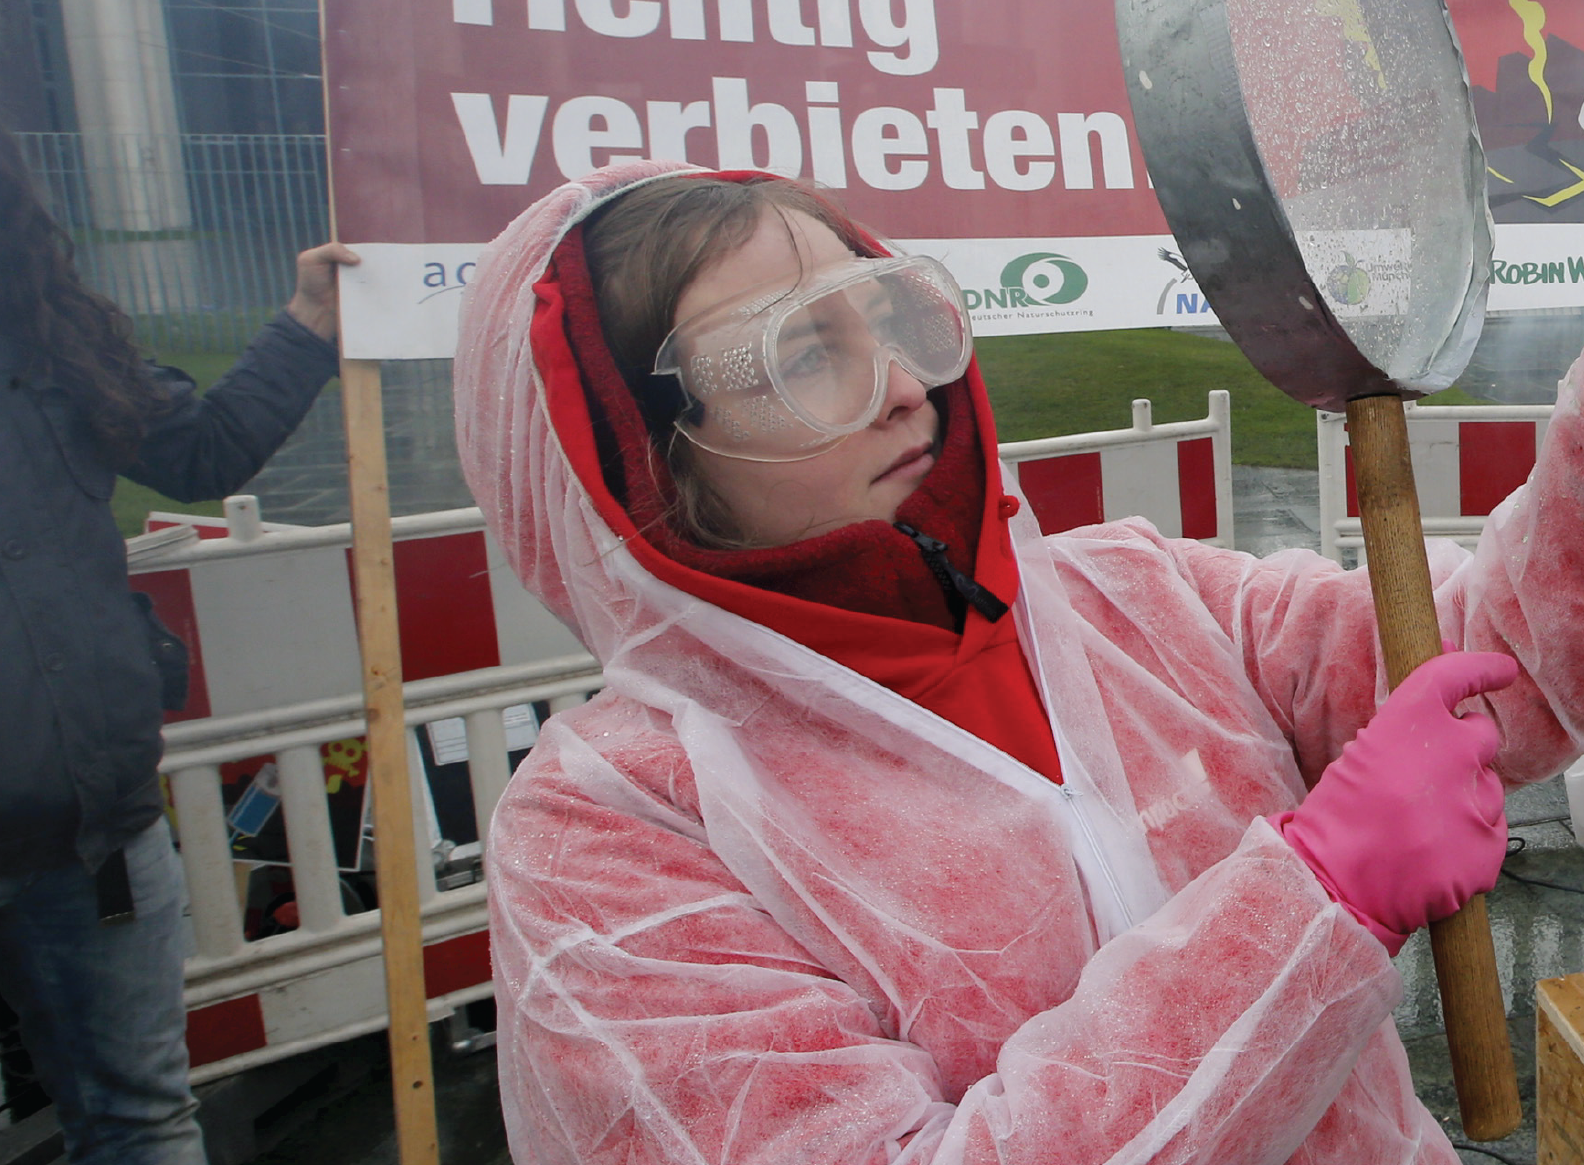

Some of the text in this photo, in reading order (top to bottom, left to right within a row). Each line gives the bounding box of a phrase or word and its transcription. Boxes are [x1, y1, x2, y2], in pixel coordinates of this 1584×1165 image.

[451, 77, 1155, 192] verbieten
[1490, 260, 1565, 284] ROBIN
[971, 312, 1012, 322] eutscher
